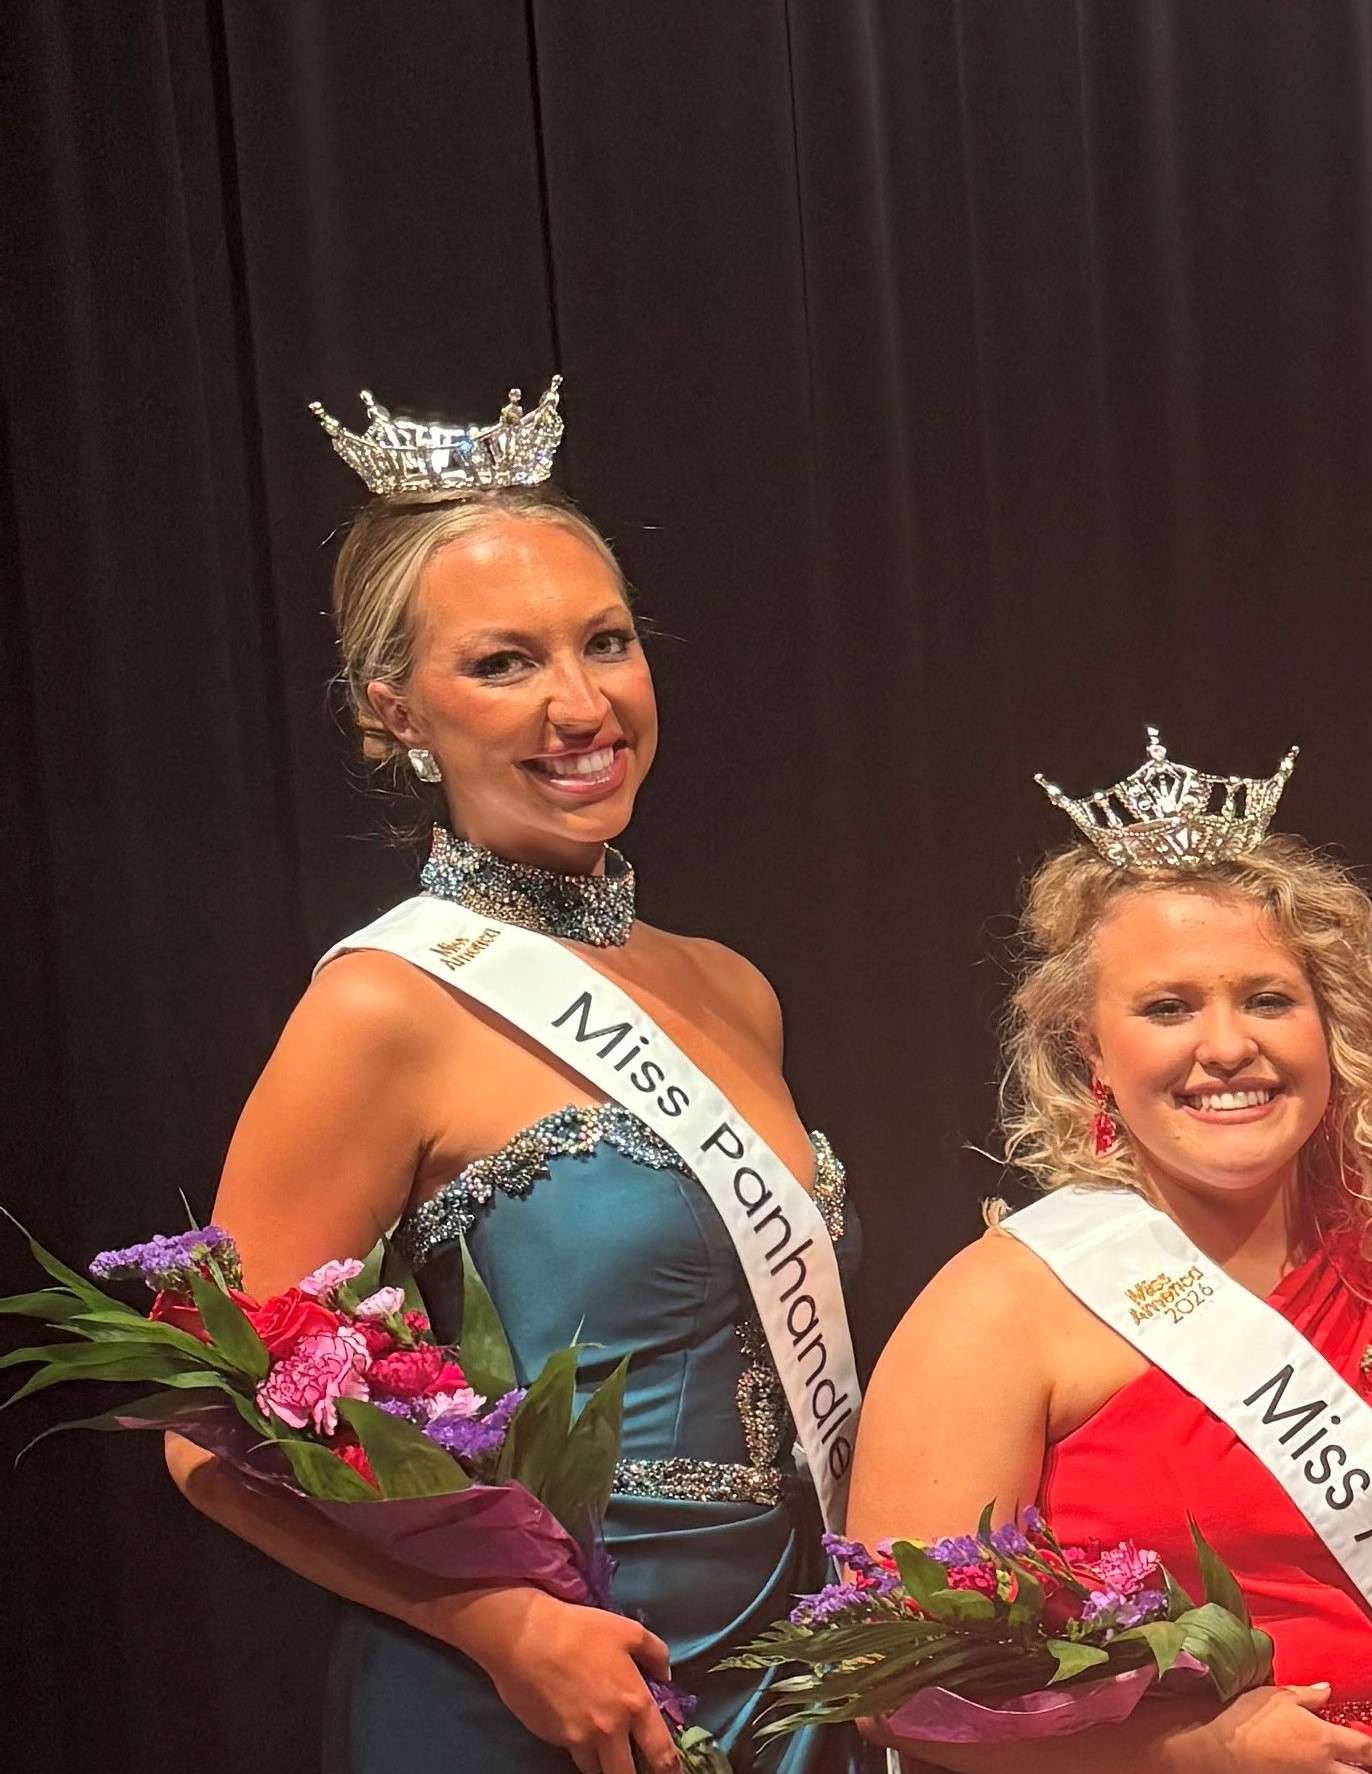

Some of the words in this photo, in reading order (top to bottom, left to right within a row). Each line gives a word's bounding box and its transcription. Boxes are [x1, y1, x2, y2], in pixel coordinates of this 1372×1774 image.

[551, 991, 691, 1118] Miss
[700, 1122, 852, 1479] Panhandle
[1164, 1283, 1215, 1325] 2026
[1243, 1363, 1371, 1511] Miss
